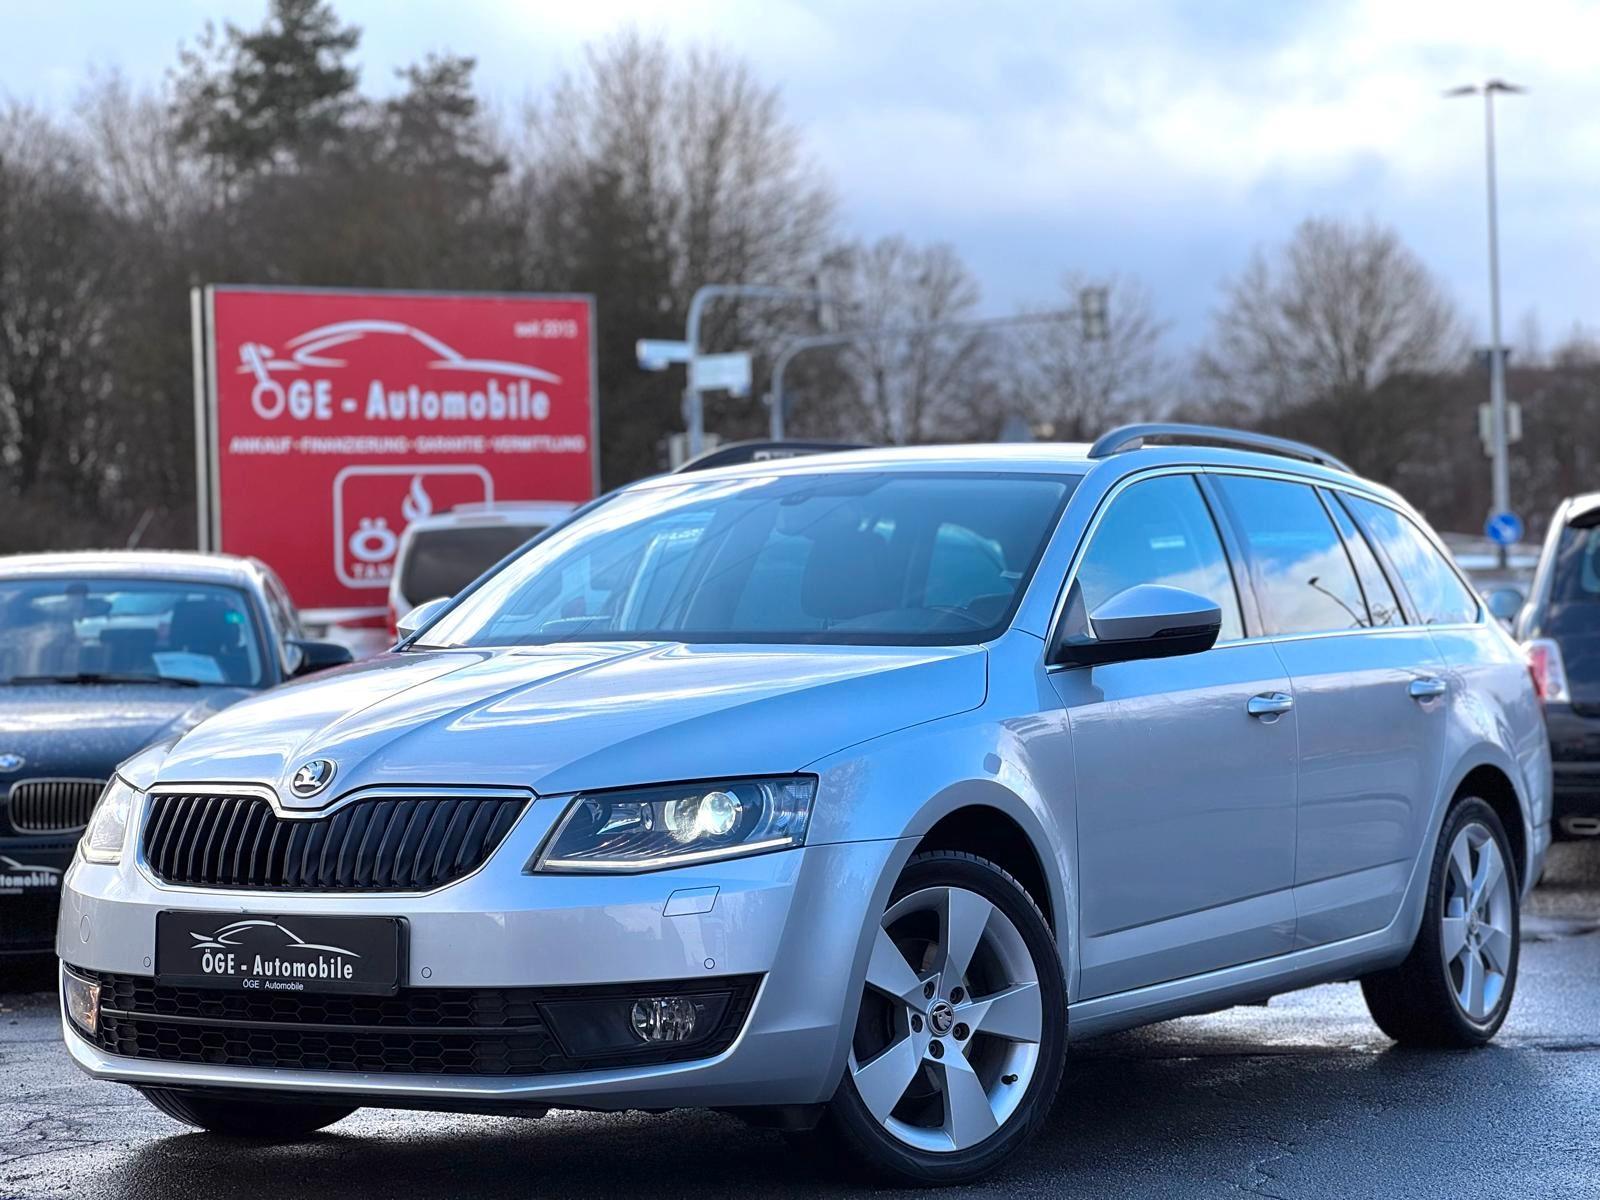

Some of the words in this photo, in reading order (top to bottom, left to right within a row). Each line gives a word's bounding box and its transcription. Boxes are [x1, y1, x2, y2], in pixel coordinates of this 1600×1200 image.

[365, 379, 551, 420] Automobile
[201, 948, 235, 975] ÖGE
[253, 954, 354, 979] Automobile
[242, 979, 260, 989] ÖGE
[264, 981, 304, 991] Automobile
